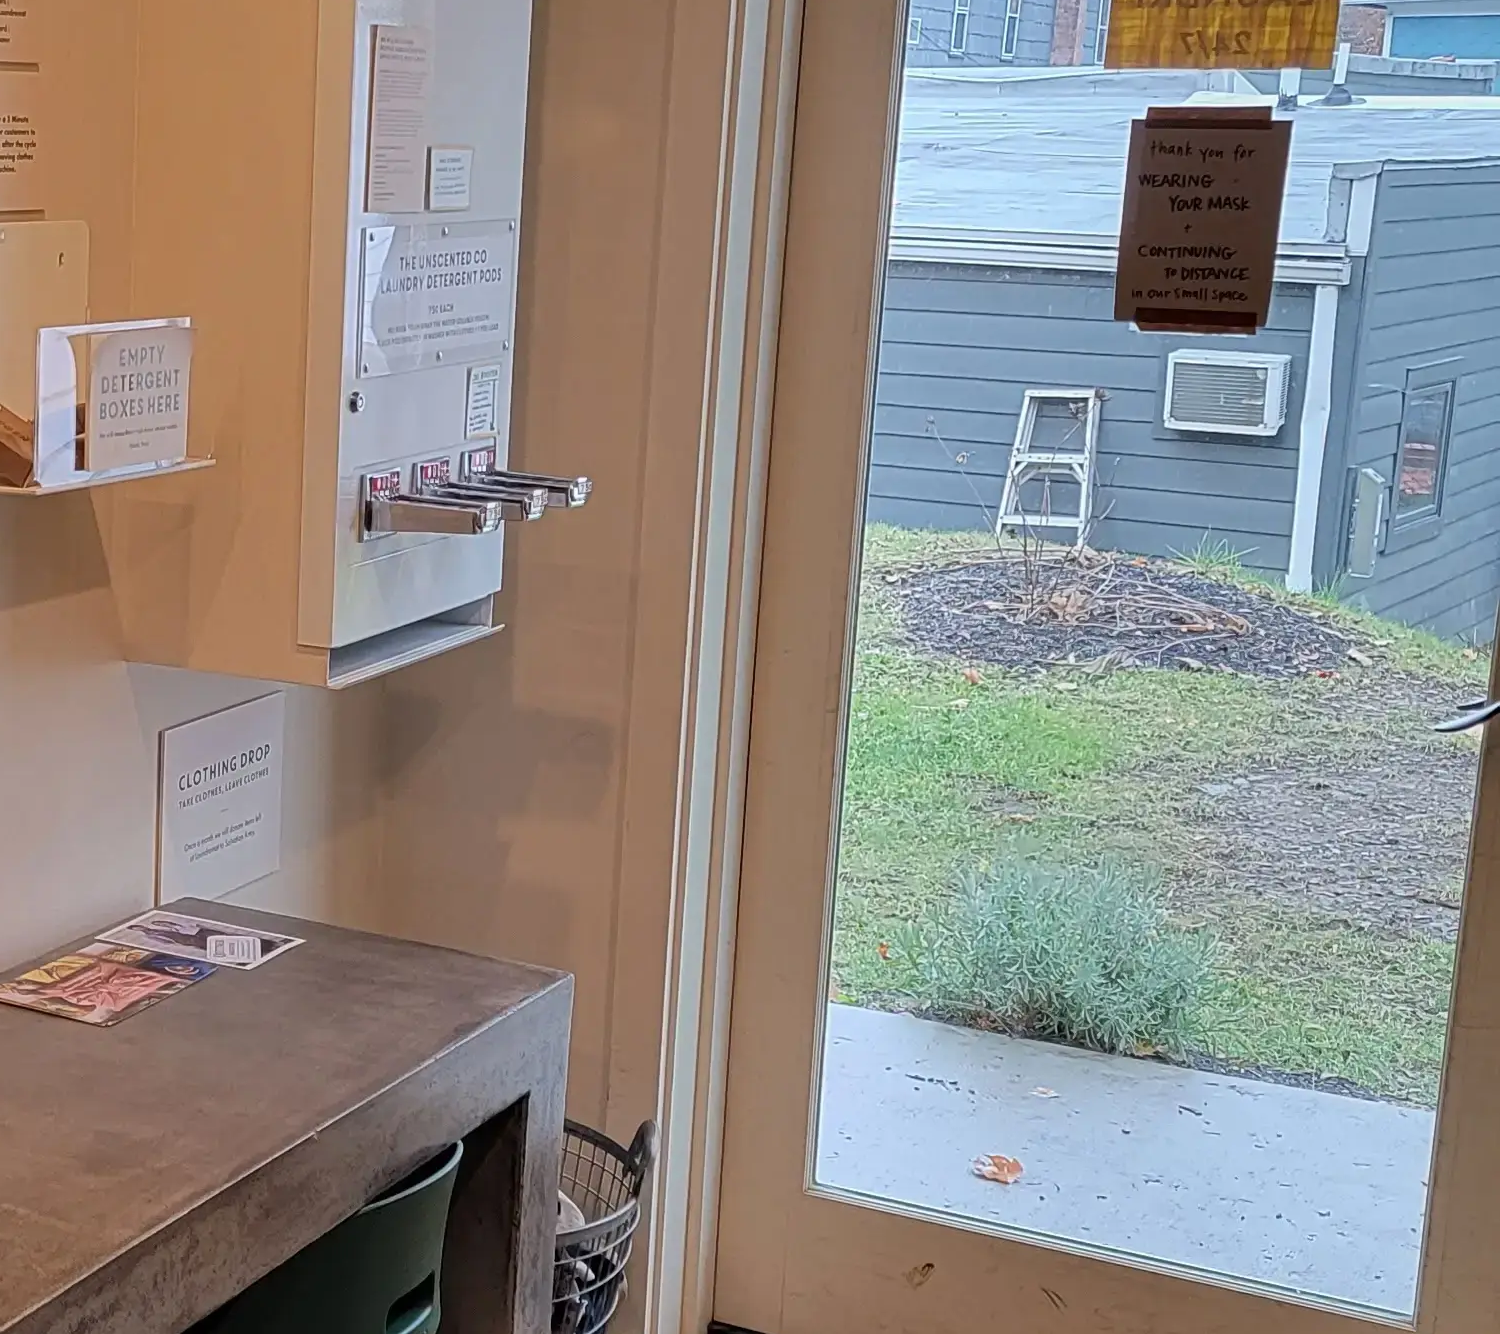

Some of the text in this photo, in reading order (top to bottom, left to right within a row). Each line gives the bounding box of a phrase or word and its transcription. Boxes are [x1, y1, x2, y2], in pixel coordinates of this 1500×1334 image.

[1151, 141, 1256, 164] thank you for
[1138, 174, 1215, 188] WEARING
[1168, 195, 1251, 212] YOUR MASK
[1184, 224, 1192, 233] +
[400, 249, 487, 271] THE UNSCENTED CO
[1138, 244, 1237, 261] CONTINUING
[380, 268, 502, 294] LAUNDRY DETERGENT PODS
[1165, 267, 1250, 281] TO DISTANCE
[1131, 289, 1143, 299] in
[1147, 290, 1171, 300] our
[1174, 286, 1208, 301] small
[119, 345, 165, 367] EMPTY
[101, 369, 180, 394] DETERGENT
[99, 393, 180, 419] BOXES HERE
[179, 744, 270, 791] CLOTHING DROP
[179, 767, 269, 809] TAKE CLOTHES, LEAVE CLOTHES
